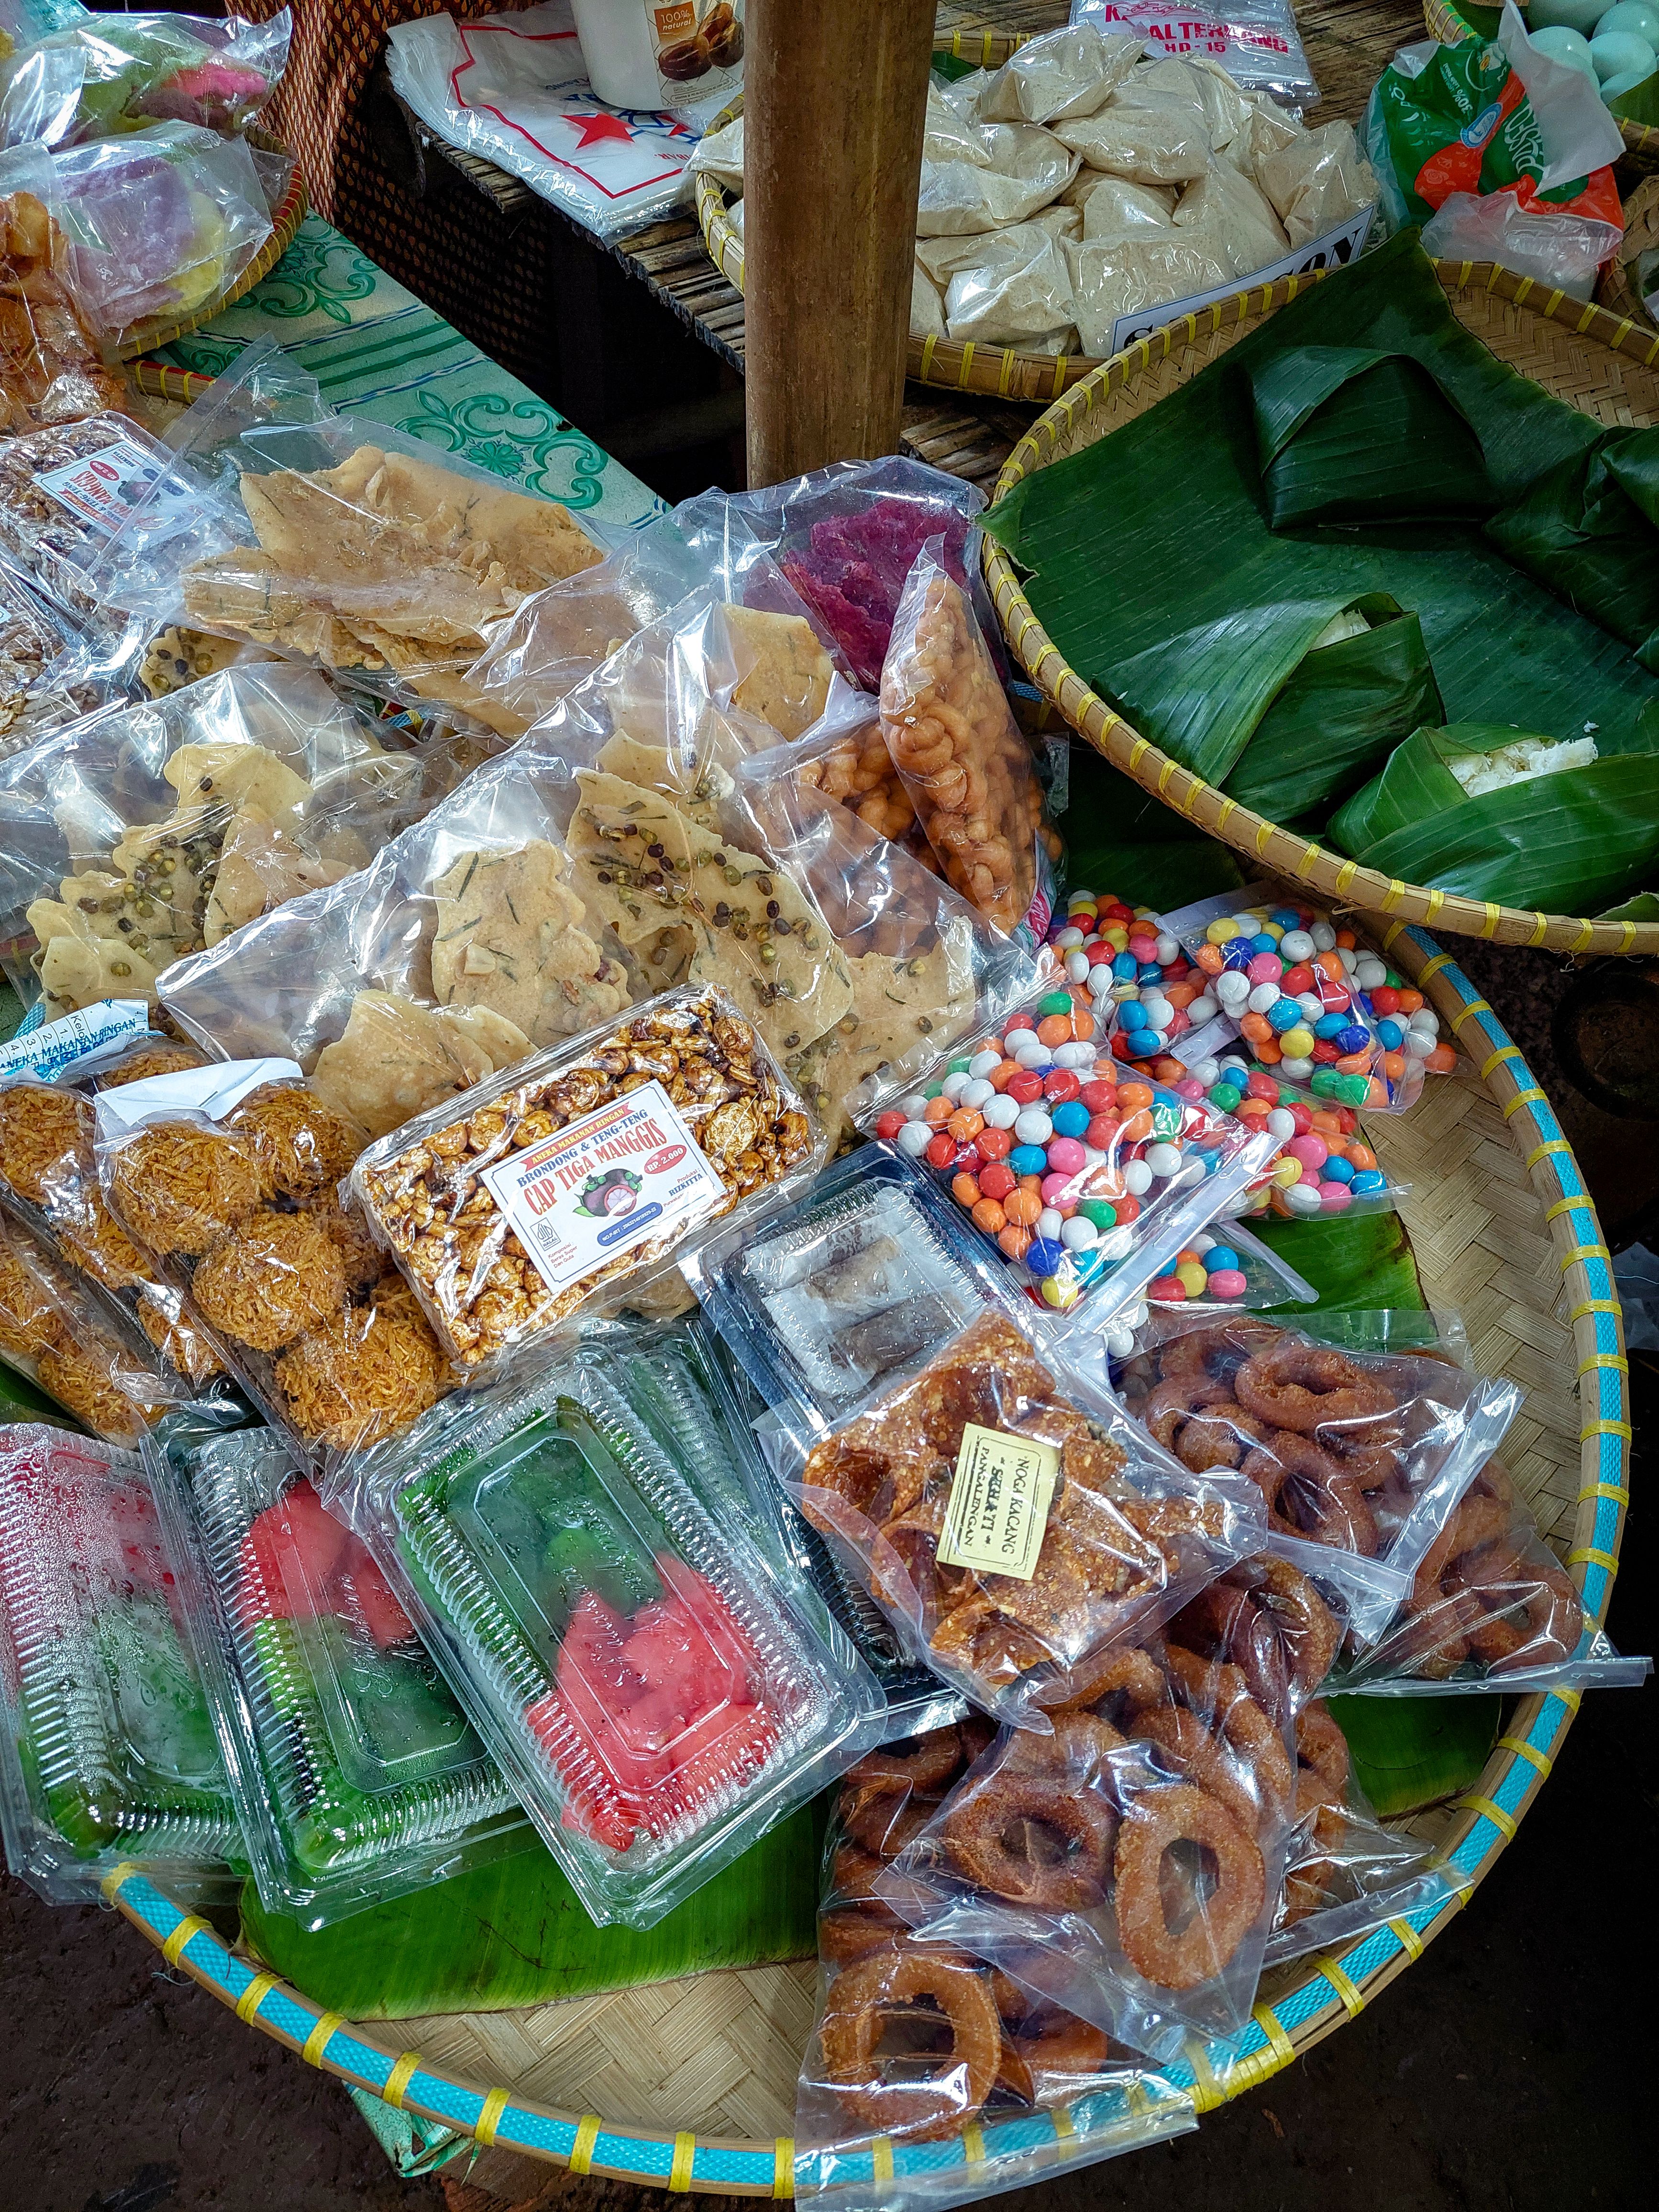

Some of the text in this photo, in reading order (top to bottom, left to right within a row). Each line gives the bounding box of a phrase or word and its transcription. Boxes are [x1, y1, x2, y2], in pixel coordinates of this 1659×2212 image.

[660, 9, 690, 23] 100%
[663, 18, 691, 31] natural
[1165, 42, 1191, 53] HD
[1206, 41, 1227, 53] 15
[1453, 90, 1473, 115] 30%
[43, 1033, 52, 1044] 2.
[59, 1028, 68, 1039] 1.
[11, 1045, 20, 1054] 4.
[26, 1040, 36, 1049] 3.
[531, 1107, 625, 1164] ANEKA MAKANAN RINGAN
[517, 1108, 649, 1188] BRONDONG & TENG-TENG
[524, 1117, 668, 1216] CAP TIGA MANGGIS
[645, 1145, 685, 1173] RP. 2.000
[668, 1173, 704, 1196] RIZKITTA
[542, 1236, 558, 1247] HALAL
[964, 1447, 989, 1546] PANGALENGAN
[1002, 1459, 1029, 1553] NOGA KACANG
